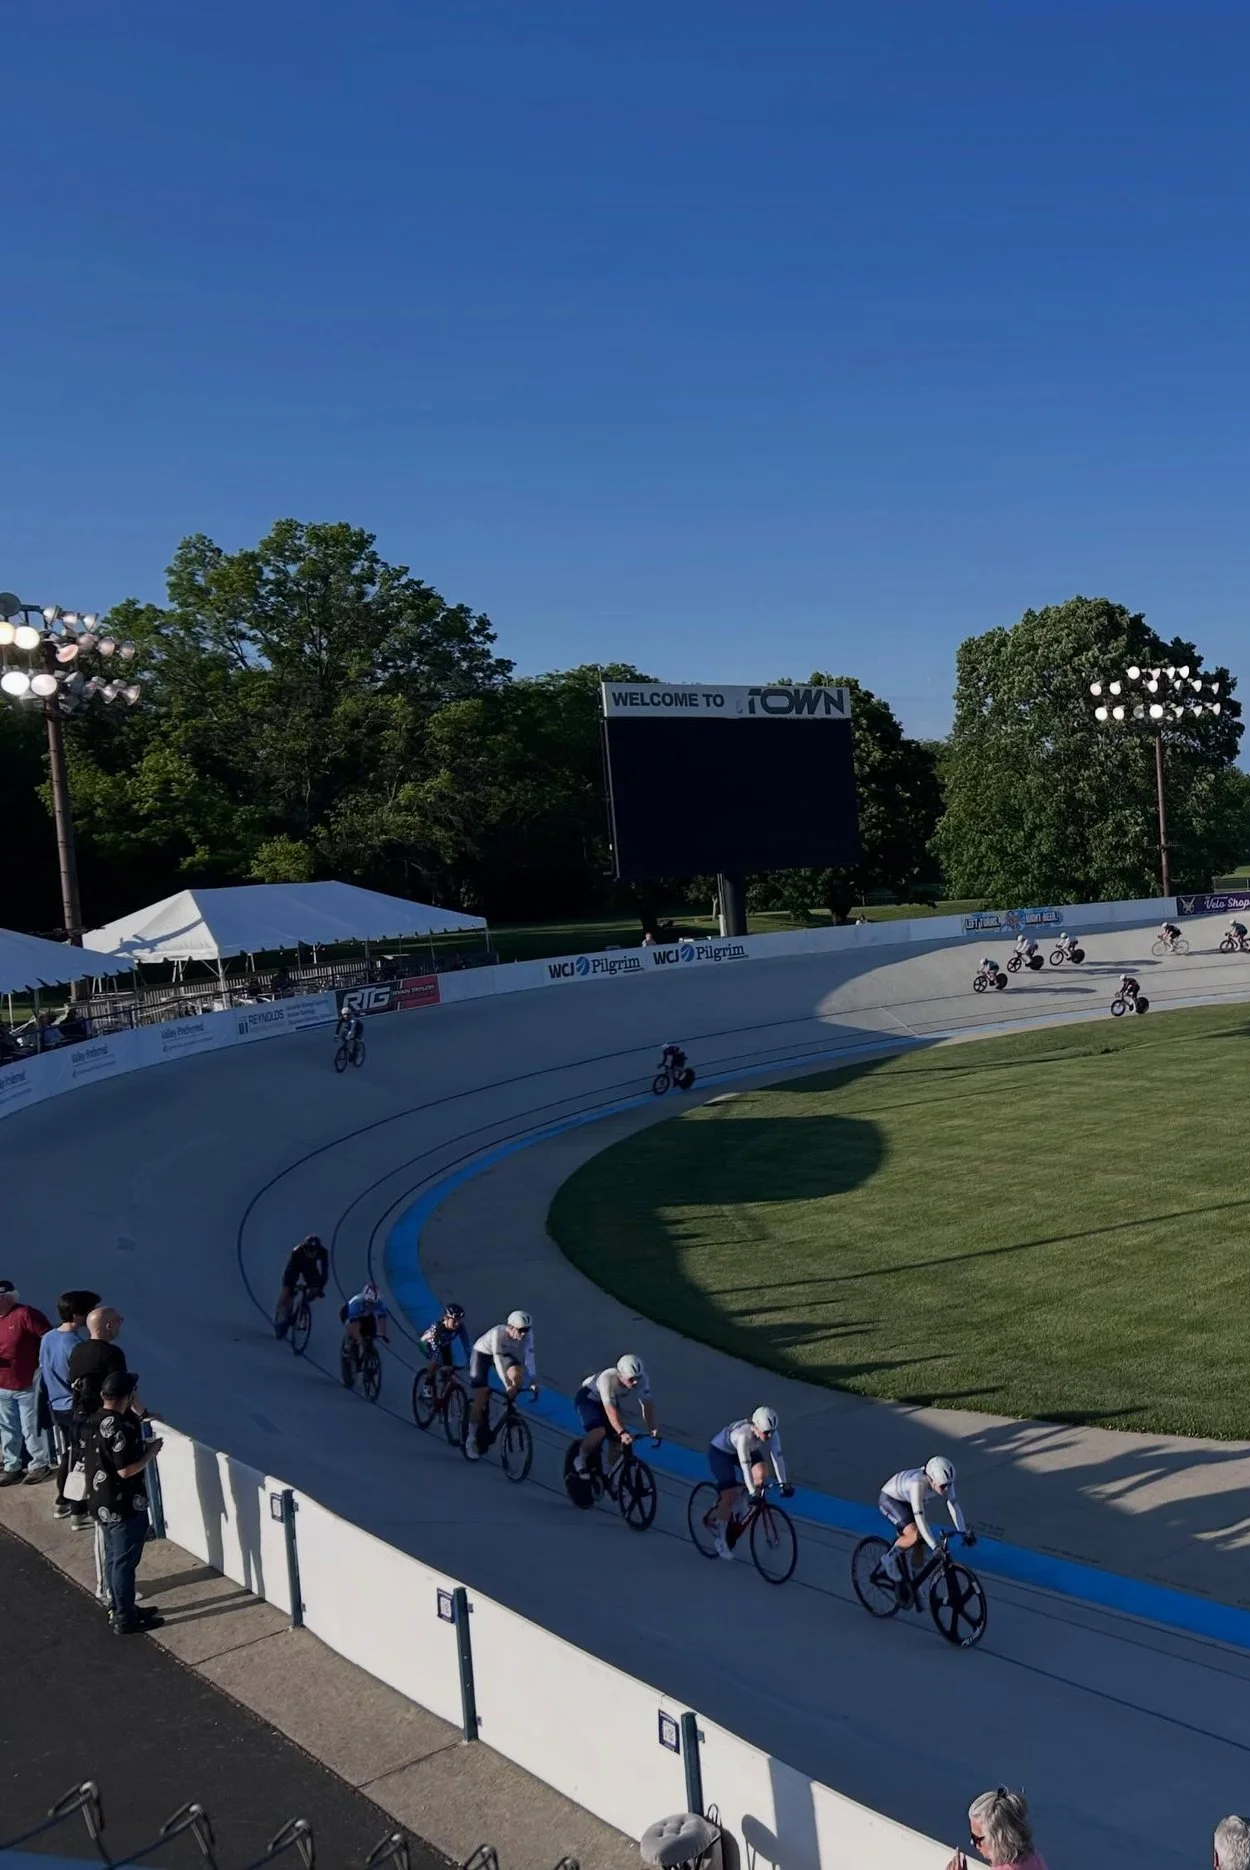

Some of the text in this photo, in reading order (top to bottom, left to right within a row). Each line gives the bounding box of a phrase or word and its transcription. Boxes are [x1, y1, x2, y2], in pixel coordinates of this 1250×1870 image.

[612, 692, 725, 707] WELCOME TO
[1204, 897, 1250, 910] Velo Shop
[653, 950, 680, 965] WCJ
[696, 943, 745, 961] Pilgrim
[549, 955, 640, 979] WCJ Pilgrim
[343, 986, 391, 1011] RTG
[249, 1009, 285, 1026] REYNOLDS
